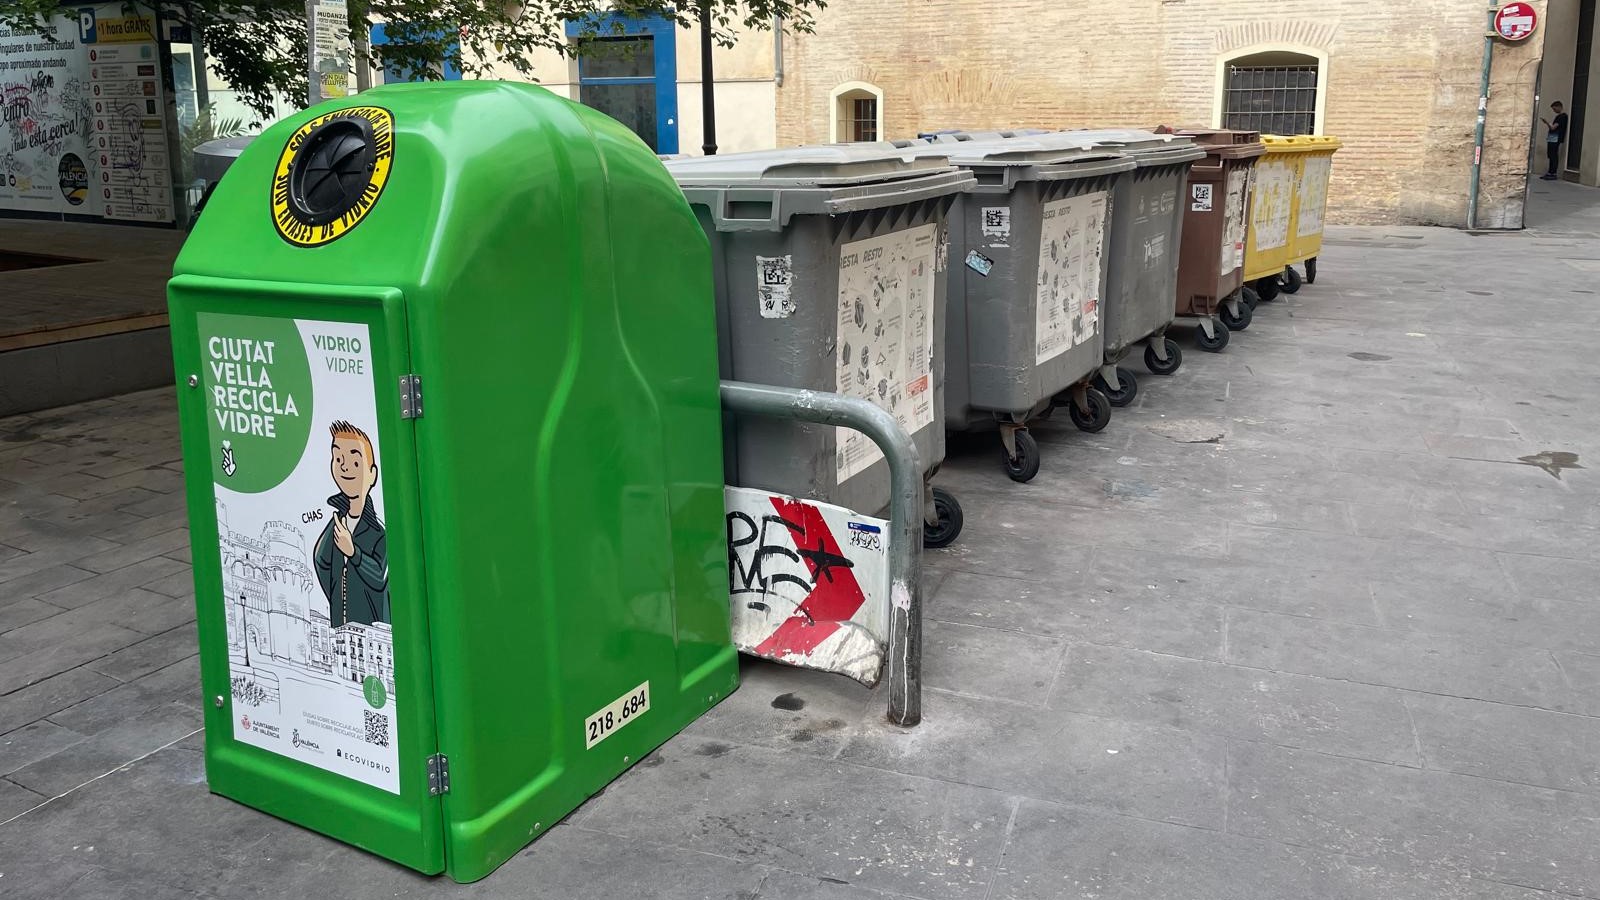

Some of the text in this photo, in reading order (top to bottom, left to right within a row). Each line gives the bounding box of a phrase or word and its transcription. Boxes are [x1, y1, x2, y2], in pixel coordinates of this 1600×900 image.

[81, 13, 94, 39] P
[106, 21, 122, 34] hora
[124, 19, 151, 34] GRATIS
[43, 57, 67, 68] andando
[321, 223, 335, 240] DE
[340, 182, 379, 228] VIDRIO
[863, 246, 884, 263] RESTO
[208, 336, 275, 364] CIUTAT
[312, 334, 362, 354] VIDRIO
[210, 361, 272, 389] VELLA
[325, 356, 364, 375] VIDRE
[214, 385, 299, 417] RECICLA
[215, 408, 276, 438] VIDRE
[301, 508, 323, 524] CHAS
[252, 719, 280, 733] AJUNTAMENT
[589, 689, 646, 742] 218.684
[344, 751, 391, 774] ECOVIDRIO
